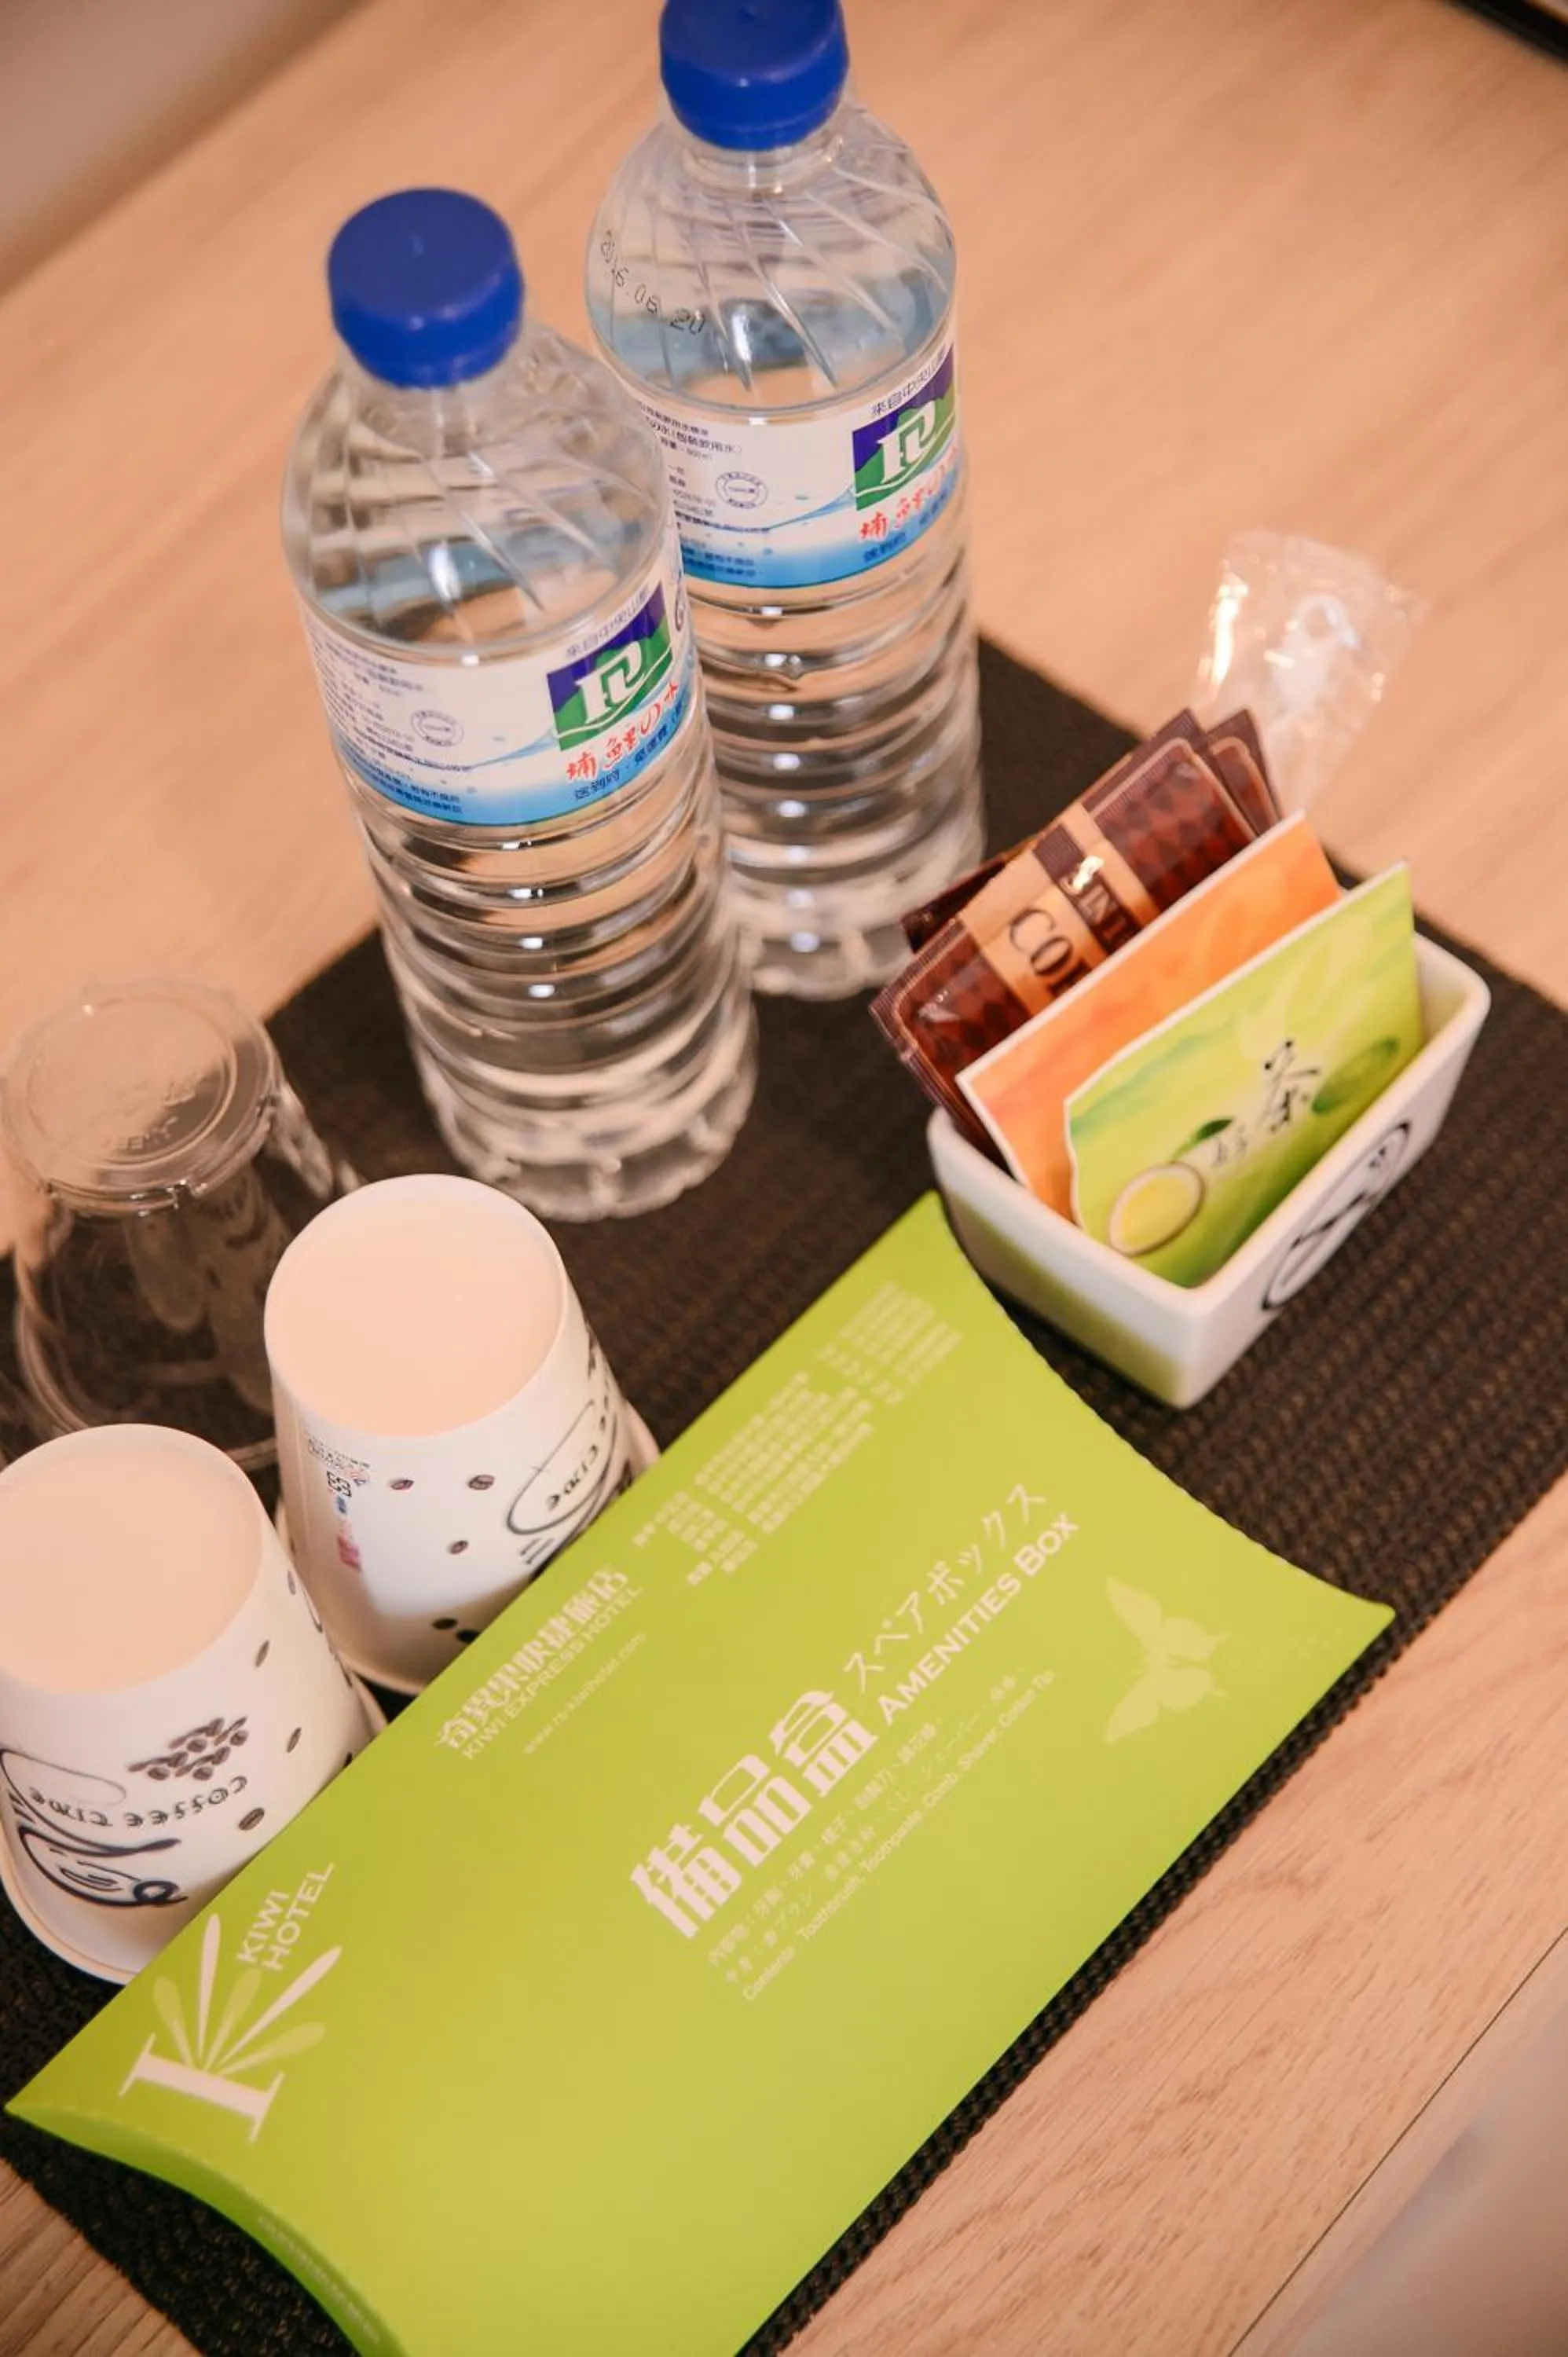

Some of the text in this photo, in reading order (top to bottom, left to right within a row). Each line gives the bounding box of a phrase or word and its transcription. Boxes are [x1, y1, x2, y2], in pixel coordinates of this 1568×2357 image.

[461, 1585, 644, 1760] KIWI EXPRESS HOTEL
[877, 1512, 1080, 1726] AMENITIES BOX
[236, 1890, 291, 1964] KIWI
[262, 1862, 335, 1972] HOTEL
